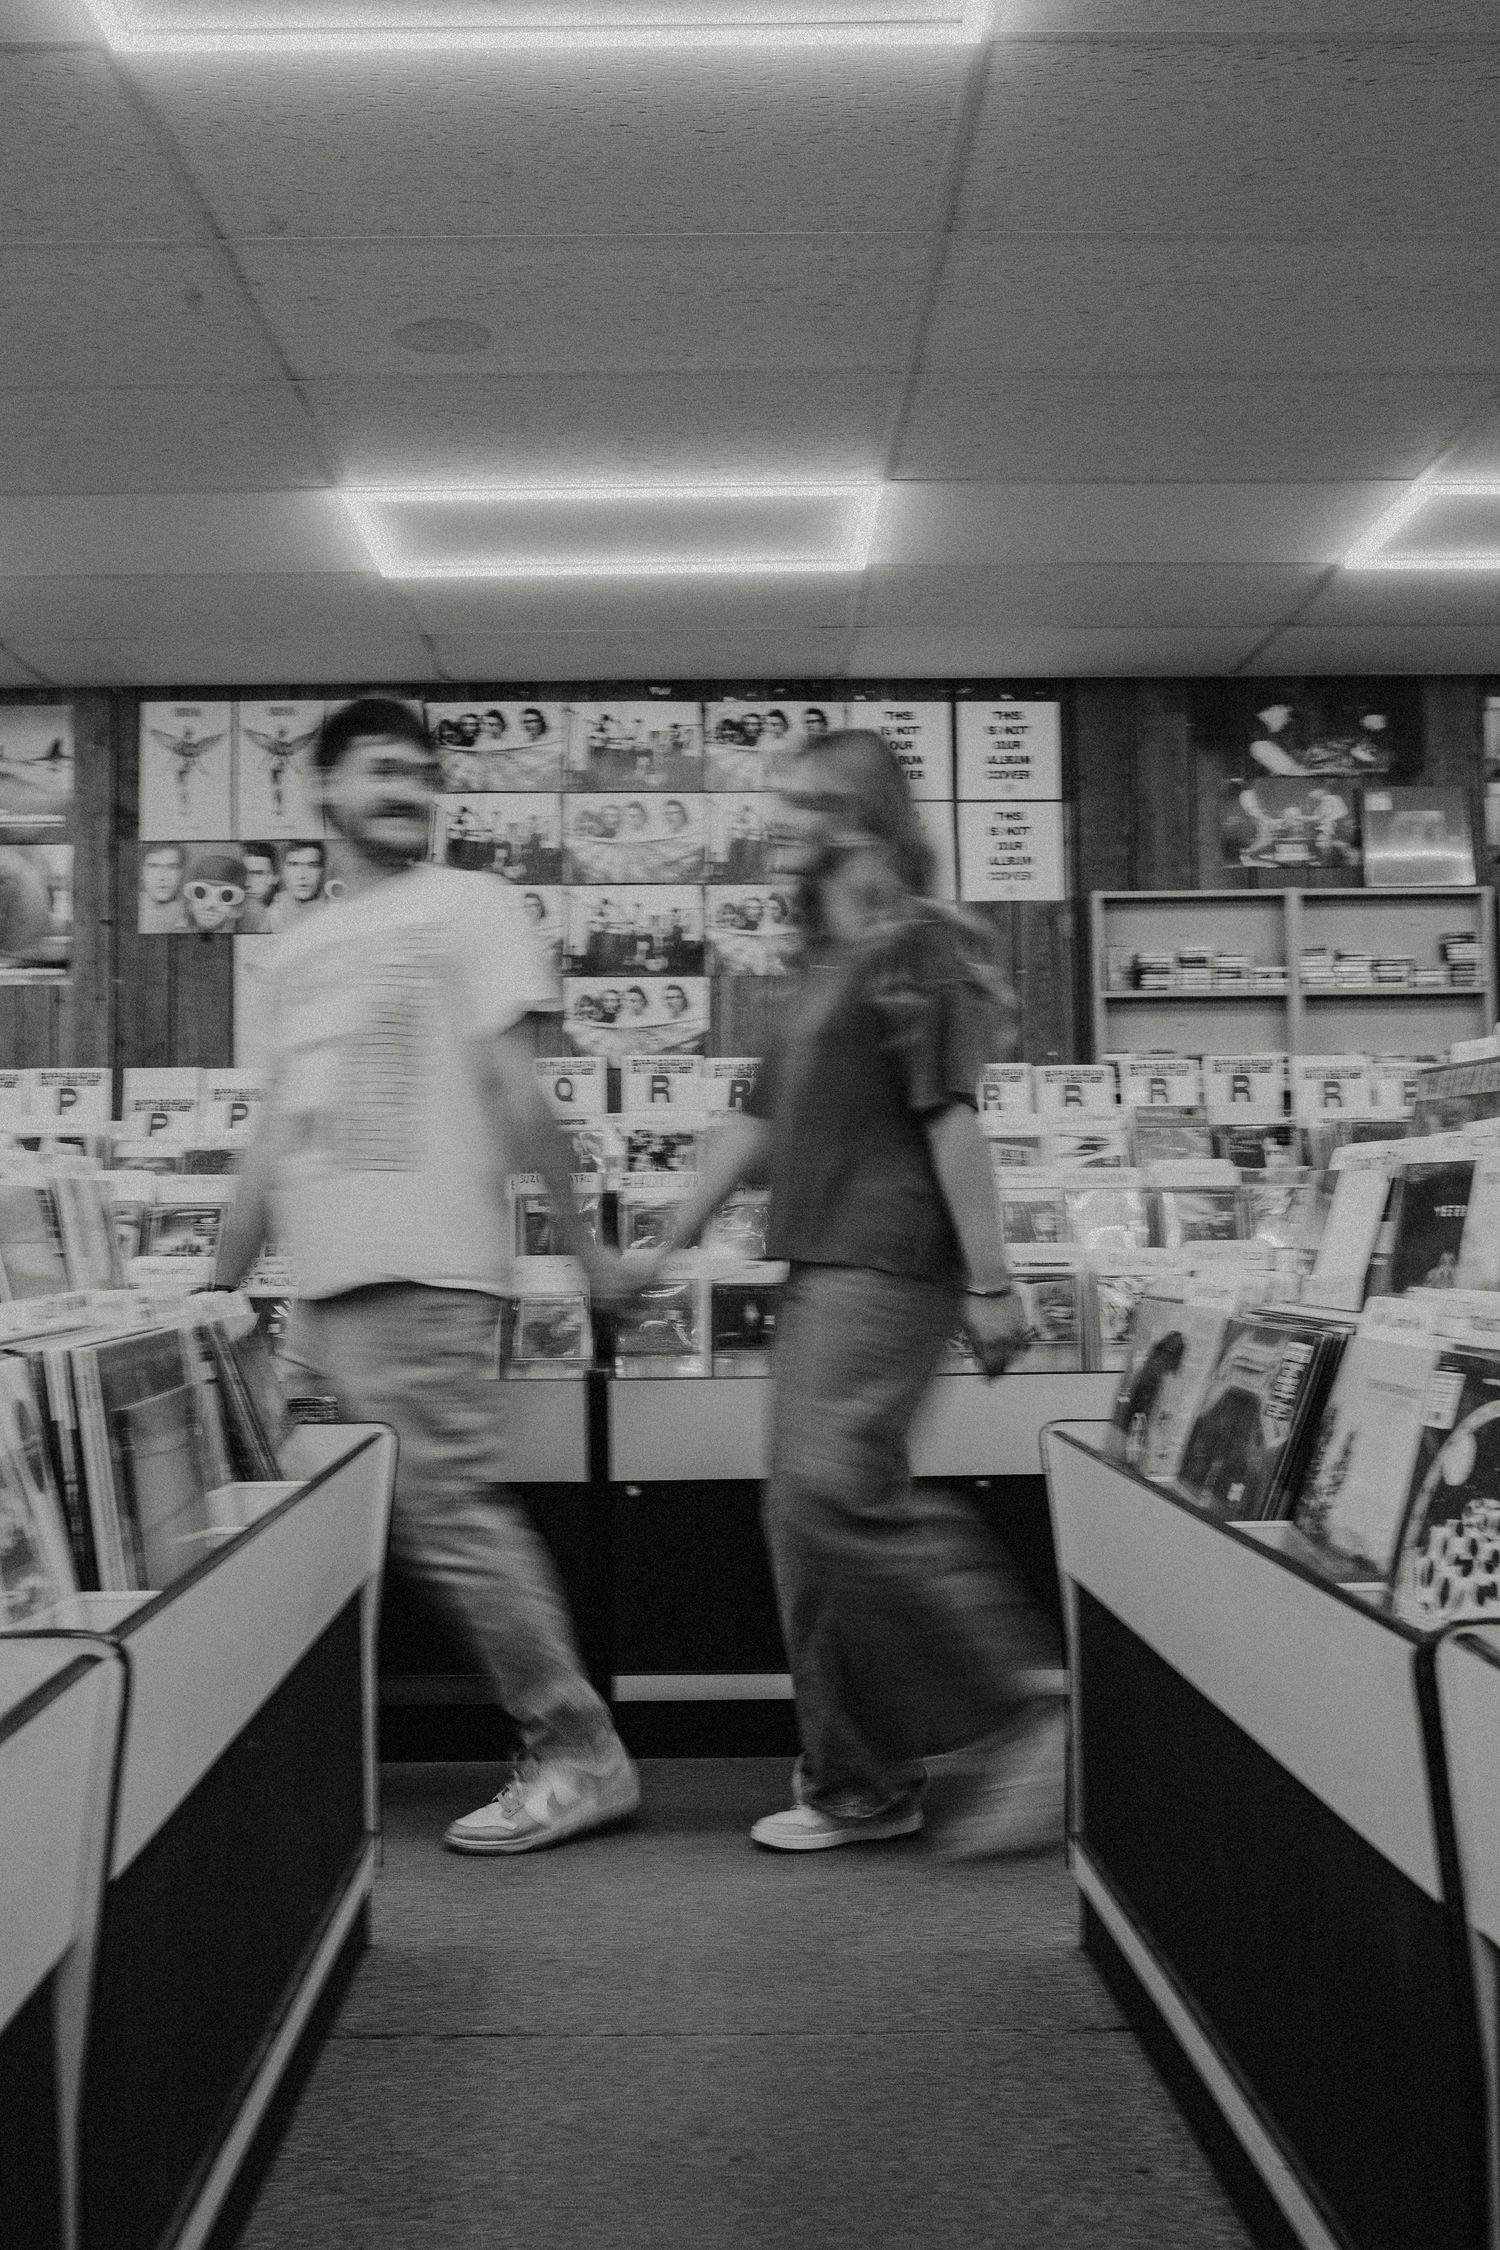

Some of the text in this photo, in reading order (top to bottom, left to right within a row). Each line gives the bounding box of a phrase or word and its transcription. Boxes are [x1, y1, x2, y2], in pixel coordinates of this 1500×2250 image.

[884, 711, 915, 720] THIS
[992, 711, 1025, 720] THIS
[881, 726, 921, 735] IS NOT
[1006, 726, 1031, 735] NOT
[889, 741, 914, 750] OUR
[995, 741, 1022, 750] OUR
[994, 812, 1026, 821] THIS
[1006, 827, 1031, 836] NOT
[997, 842, 1024, 851] OUR
[554, 1077, 574, 1102] Q
[650, 1075, 671, 1103] R
[729, 1079, 750, 1108] R
[983, 1084, 1001, 1111] R
[1064, 1085, 1084, 1107] R
[1150, 1078, 1168, 1103] R
[1231, 1075, 1252, 1102] R
[1324, 1081, 1343, 1108] R
[58, 1088, 78, 1115] P
[148, 1113, 169, 1137] P
[231, 1103, 249, 1129] P
